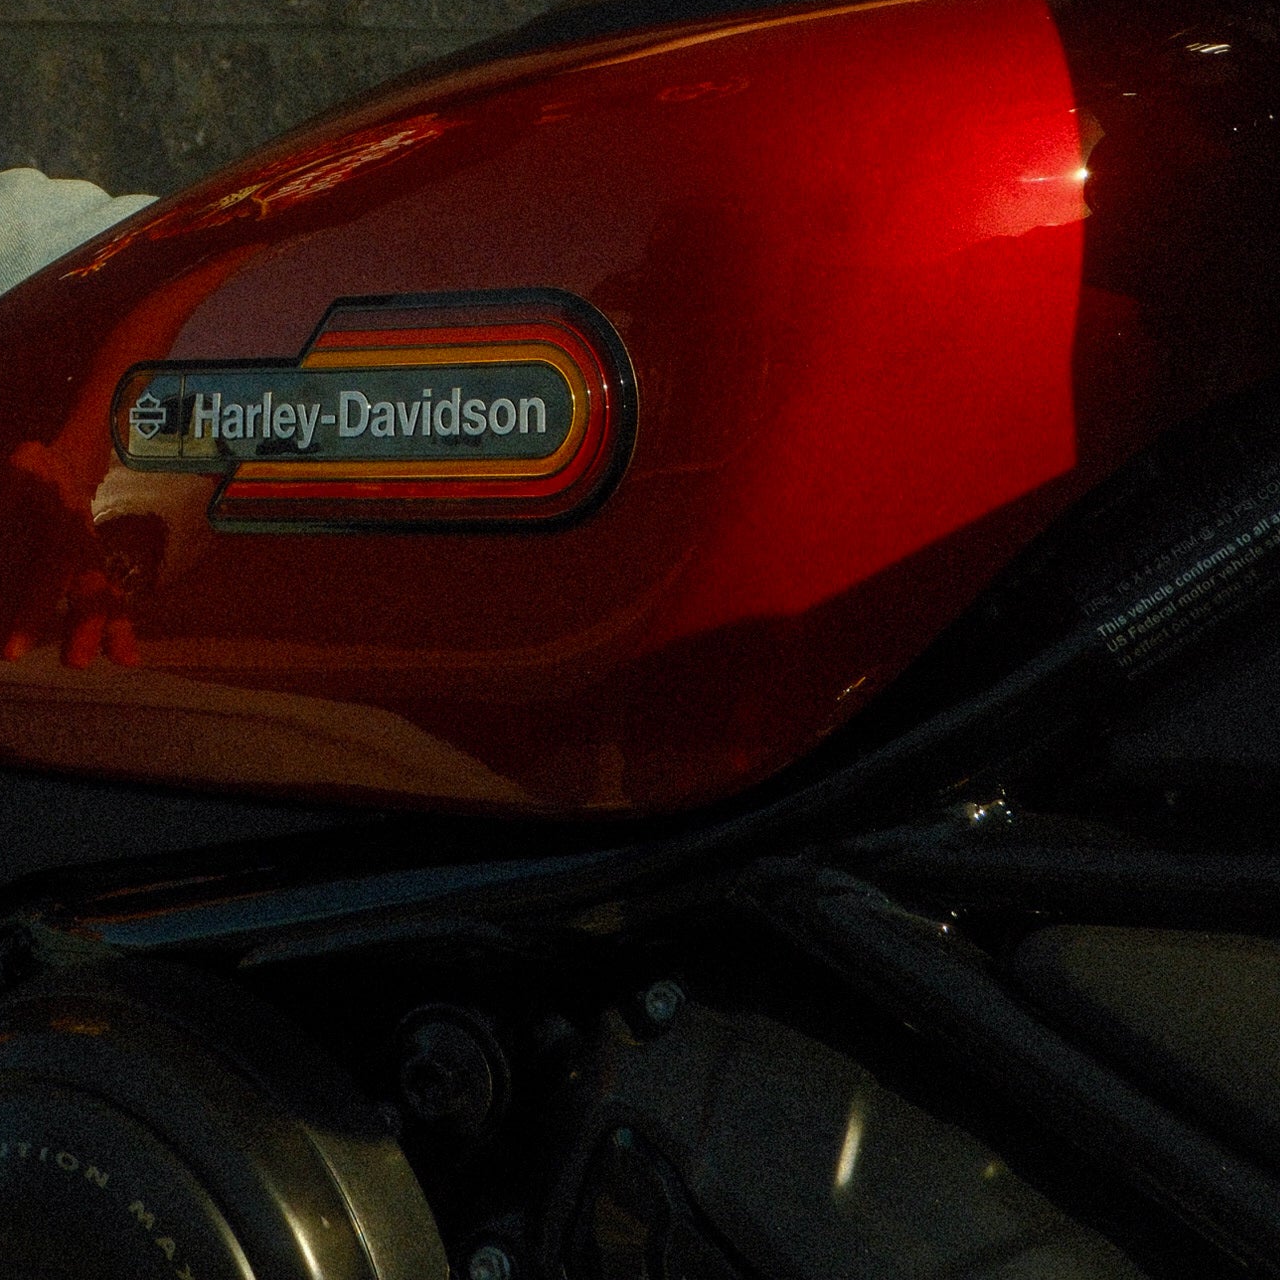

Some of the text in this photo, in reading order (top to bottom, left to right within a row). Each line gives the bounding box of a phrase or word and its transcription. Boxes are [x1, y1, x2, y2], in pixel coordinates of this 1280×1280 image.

[194, 386, 547, 449] Harley-Davidson
[1096, 611, 1128, 639] This
[1125, 581, 1174, 619] vehicle
[1178, 540, 1236, 584] conforms
[1234, 530, 1252, 547] to
[1250, 518, 1270, 536] all
[1105, 633, 1128, 653] US
[1126, 599, 1177, 639] Federal
[1175, 574, 1217, 606] motor
[1216, 543, 1265, 581] vehicle
